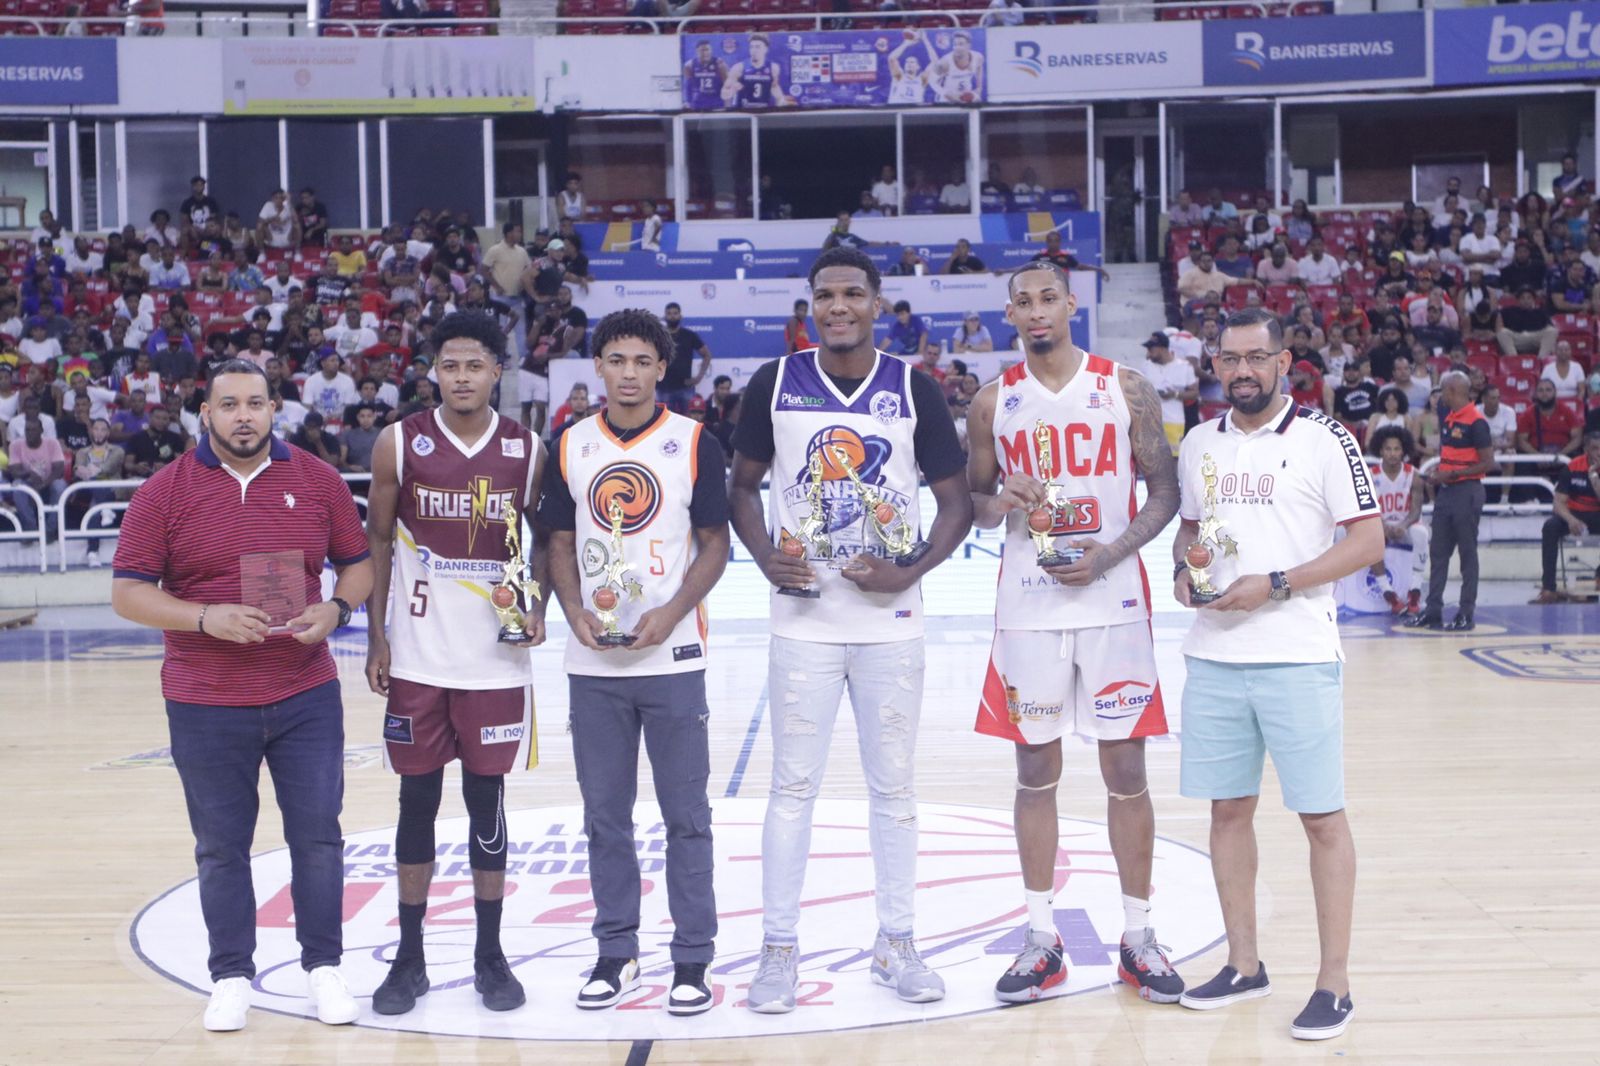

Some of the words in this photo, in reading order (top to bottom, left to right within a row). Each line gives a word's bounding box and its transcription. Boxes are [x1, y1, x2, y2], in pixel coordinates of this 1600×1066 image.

[1048, 51, 1168, 68] BANRESERVAS
[1270, 40, 1394, 60] BANRESERVAS
[999, 423, 1118, 480] MOCA
[1307, 412, 1372, 506] RALPHLAUREN
[1212, 472, 1275, 498] OLO
[1211, 496, 1274, 506] LPHLAUREN
[434, 560, 506, 573] BANRESERV
[649, 539, 665, 576] 5
[410, 580, 429, 618] 5
[1095, 692, 1153, 711] Serkasa
[482, 725, 525, 740] iMney
